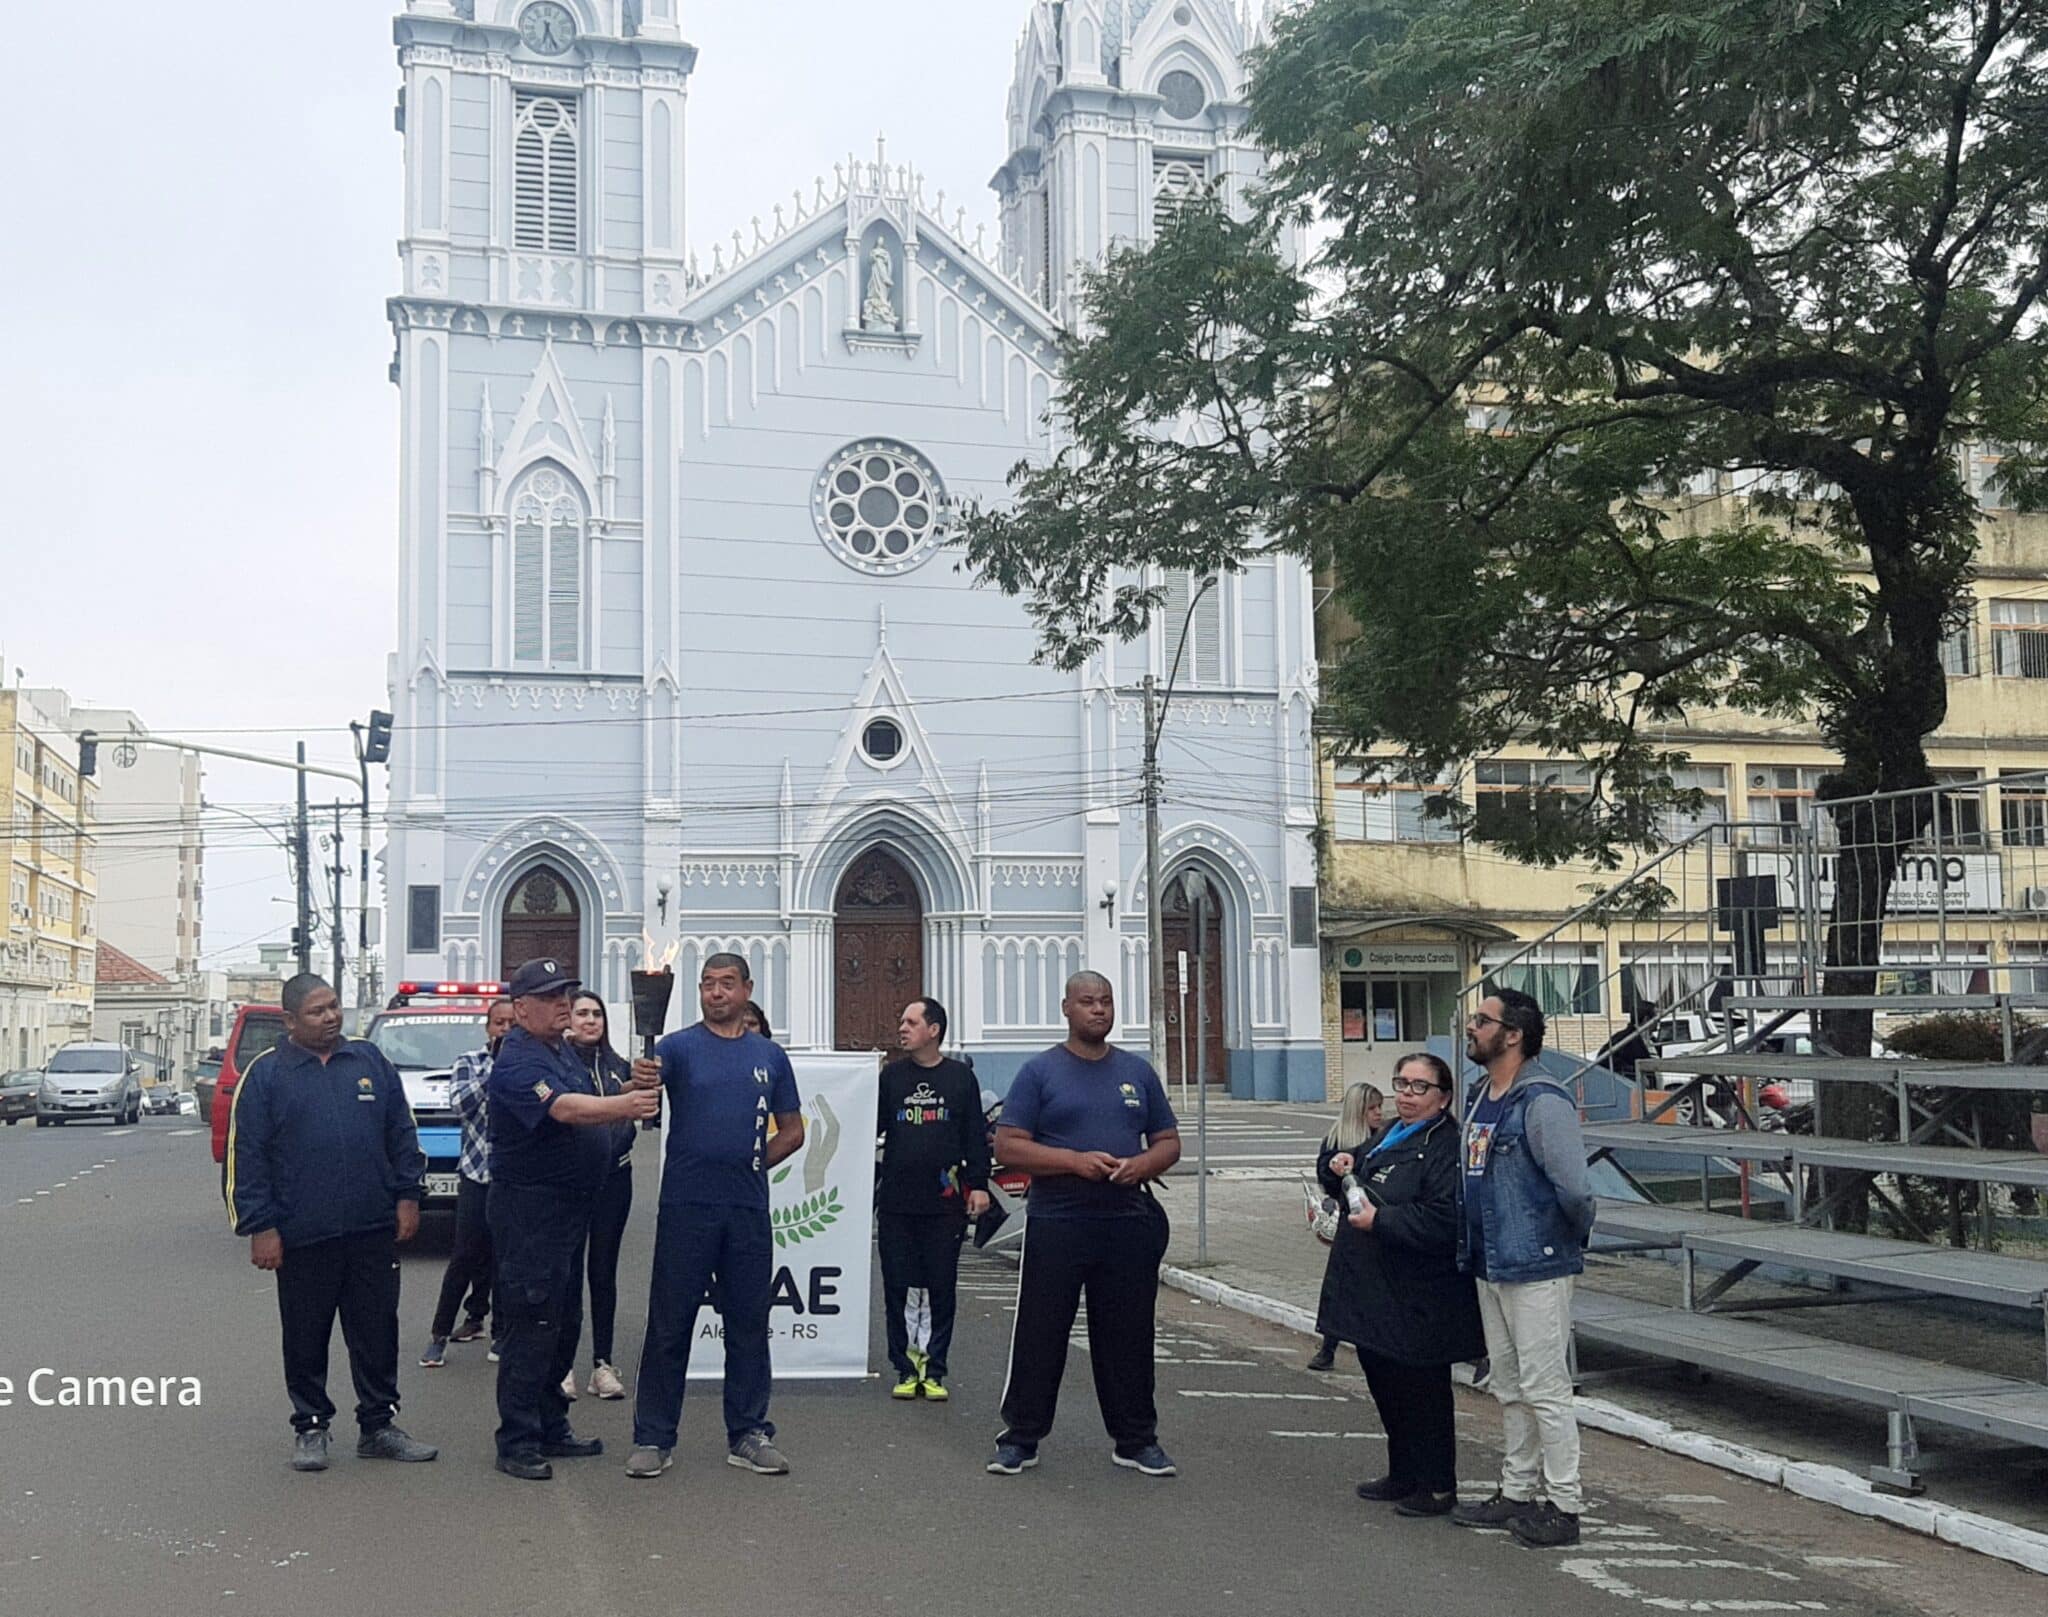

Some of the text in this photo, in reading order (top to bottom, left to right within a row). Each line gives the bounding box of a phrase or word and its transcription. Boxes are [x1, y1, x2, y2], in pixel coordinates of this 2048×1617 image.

[1926, 890, 1970, 900] Capanha
[896, 1106, 950, 1125] NORMAL
[791, 1322, 819, 1340] RS
